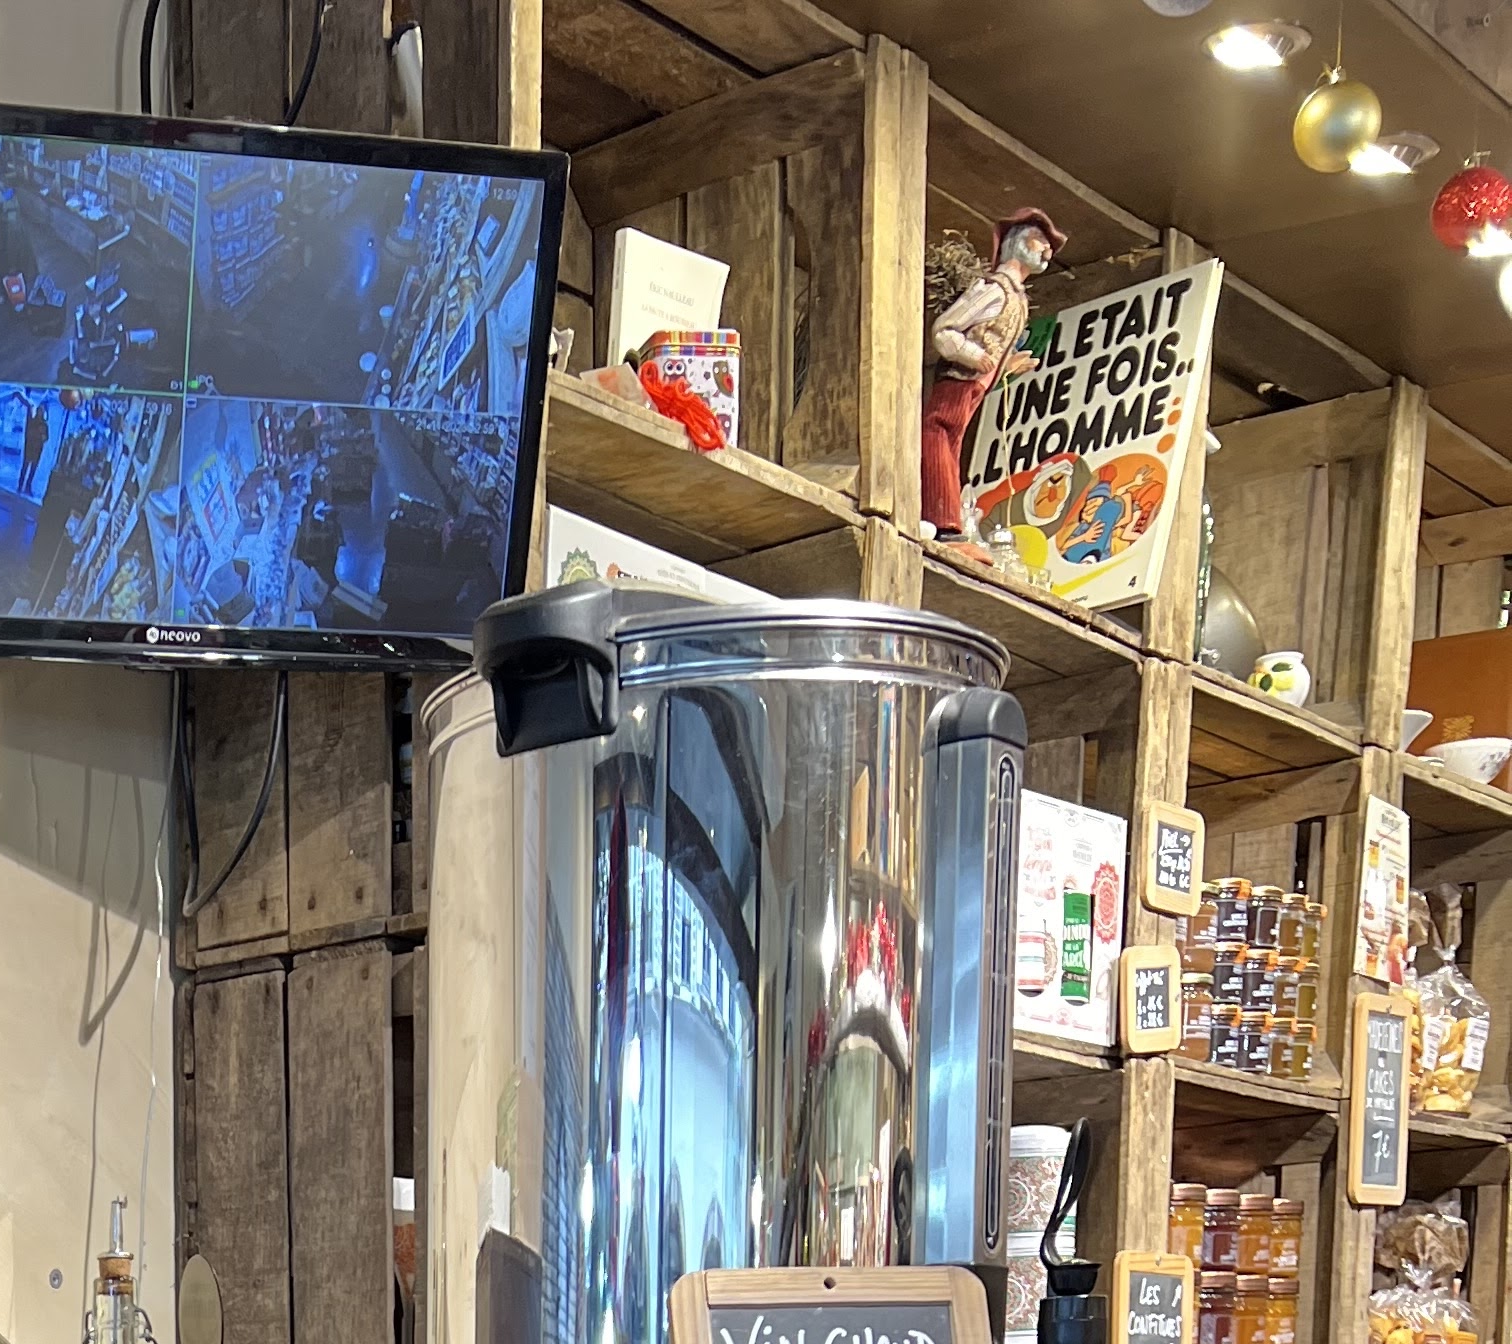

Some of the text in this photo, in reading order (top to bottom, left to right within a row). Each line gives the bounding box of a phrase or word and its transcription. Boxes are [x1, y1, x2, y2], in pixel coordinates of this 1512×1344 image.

[1073, 278, 1192, 358] ETAIT
[996, 366, 1076, 431] UNE
[1128, 576, 1137, 587] 4
[160, 630, 201, 643] neovo
[1140, 1277, 1160, 1305] LES
